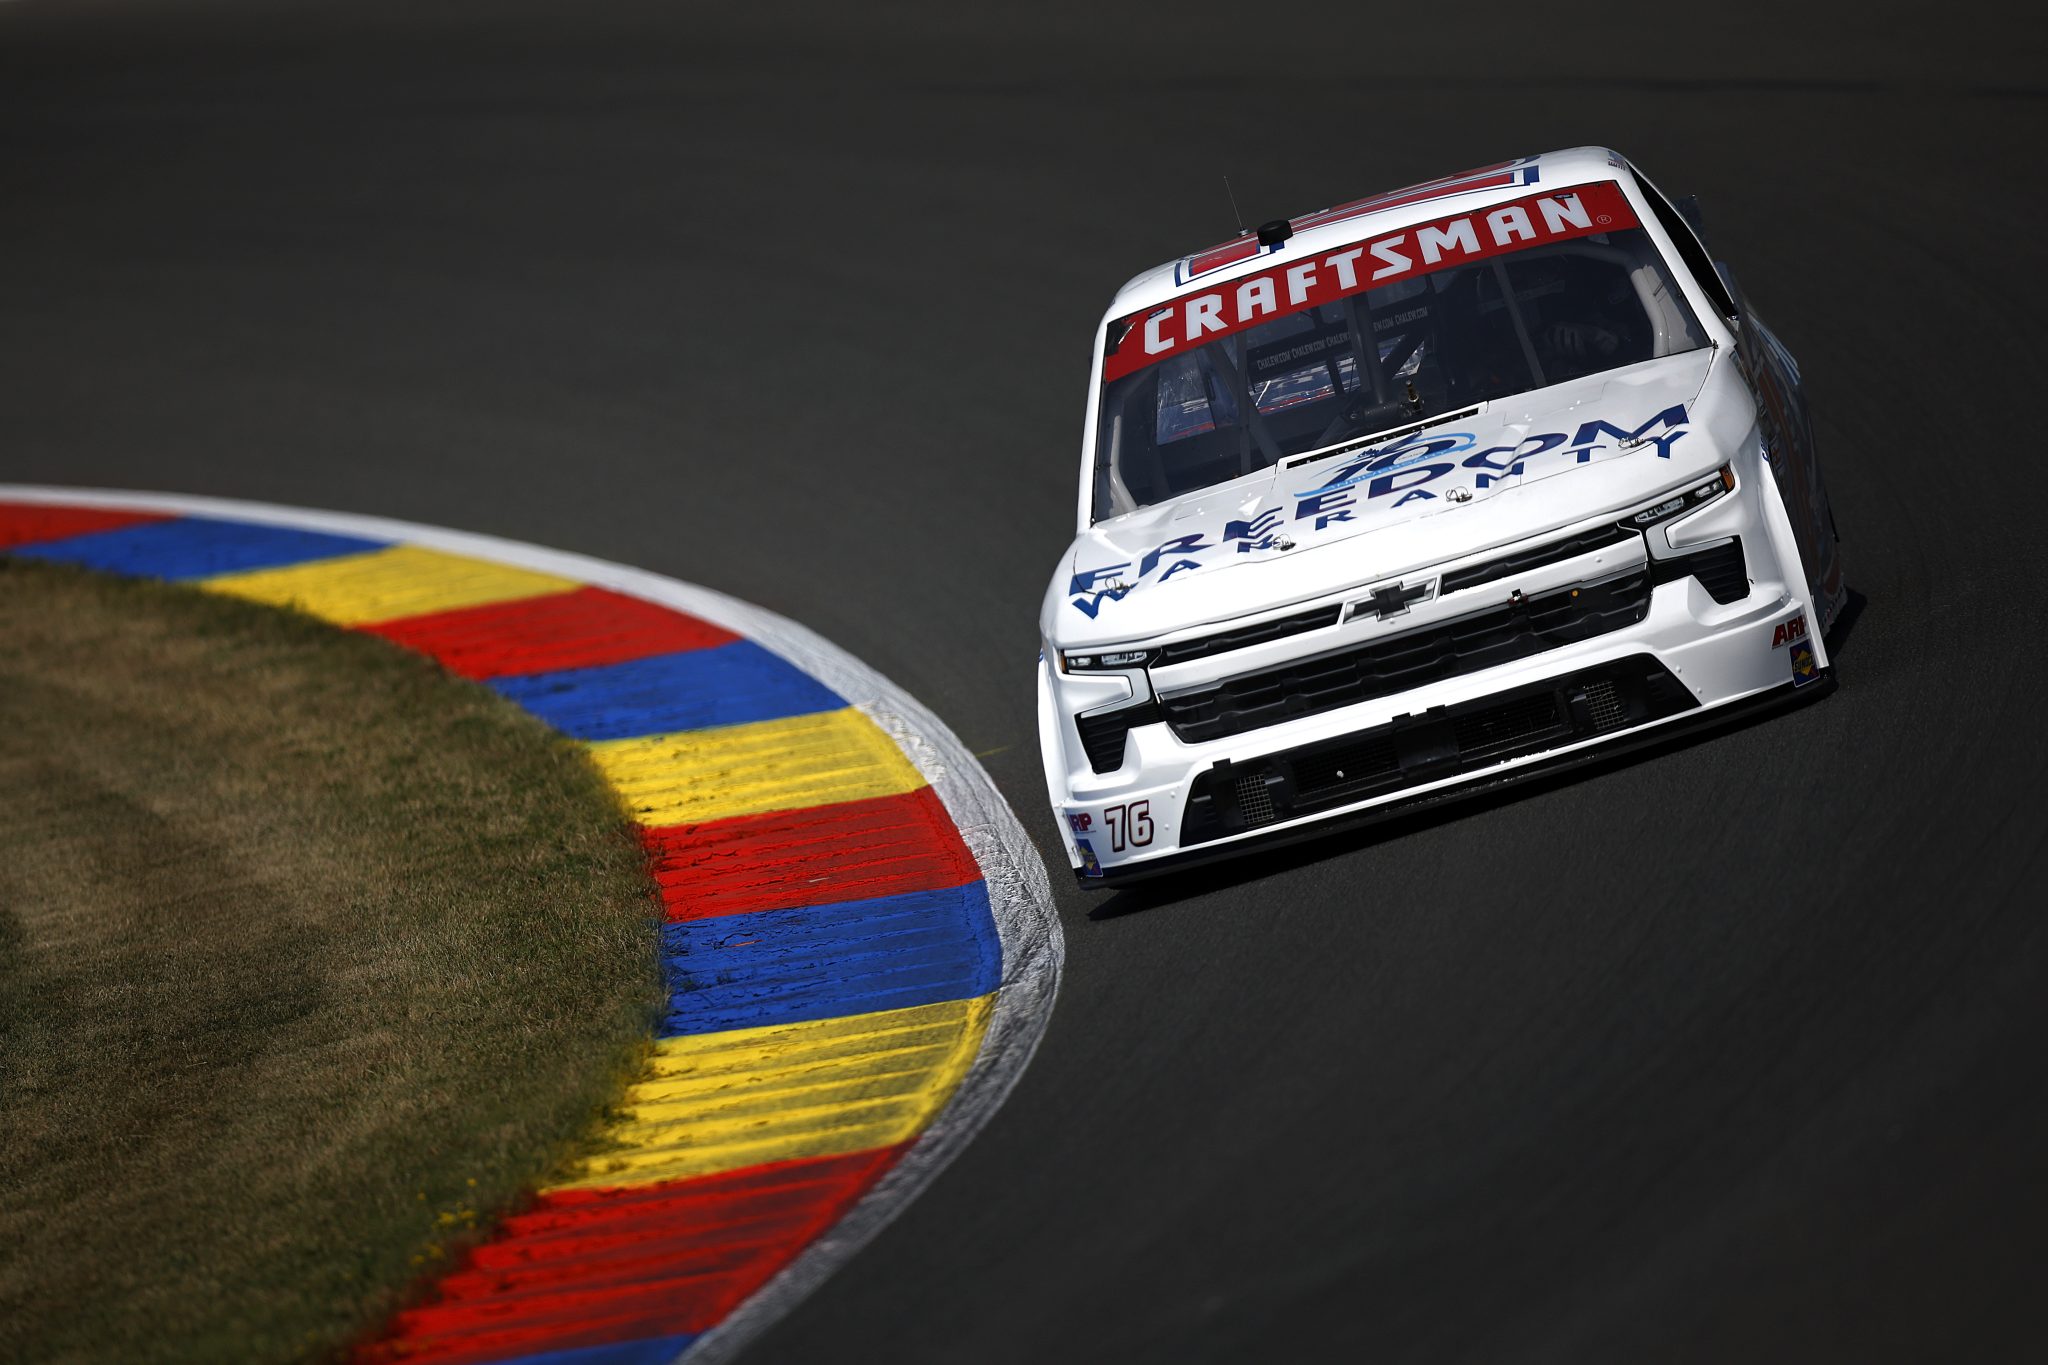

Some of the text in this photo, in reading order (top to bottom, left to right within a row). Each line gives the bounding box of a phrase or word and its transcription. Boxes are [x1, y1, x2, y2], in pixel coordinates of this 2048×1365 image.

[1069, 403, 1689, 597] FREEDOM
[1072, 431, 1688, 620] WARRANTY
[1104, 799, 1154, 852] 76
